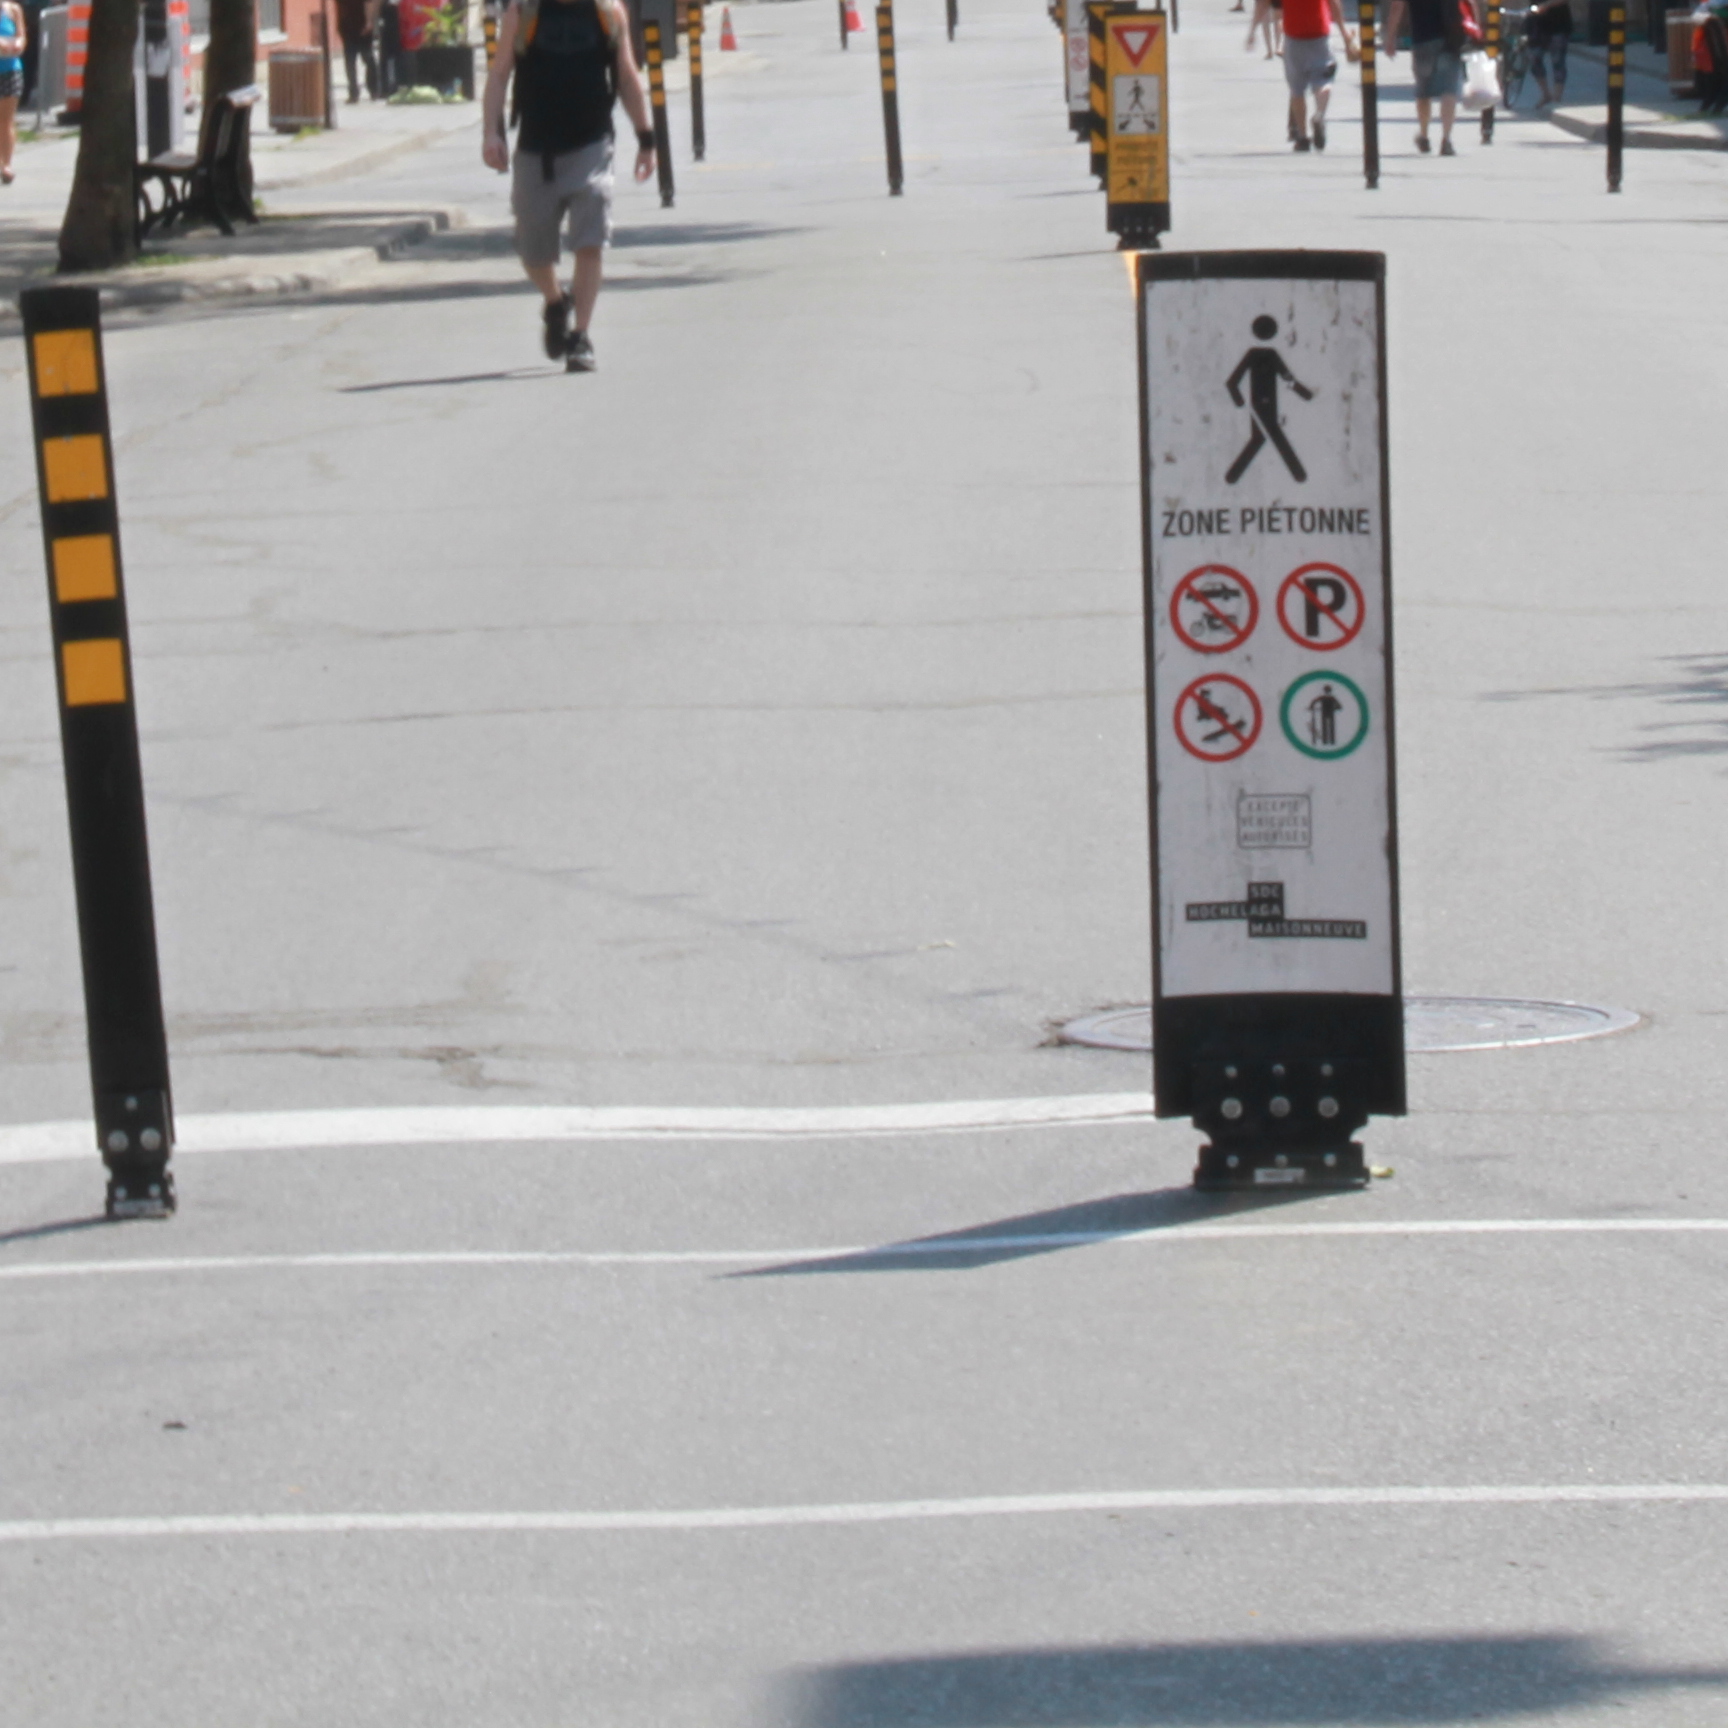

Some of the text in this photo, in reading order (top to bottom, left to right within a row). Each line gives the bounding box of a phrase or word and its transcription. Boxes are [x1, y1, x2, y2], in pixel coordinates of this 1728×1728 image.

[1162, 497, 1371, 538] ZONE PIÉTONNE
[1249, 885, 1281, 899] SDC
[1188, 901, 1281, 919] HOCHELAGA
[1250, 920, 1364, 937] MAISONNEUVE
